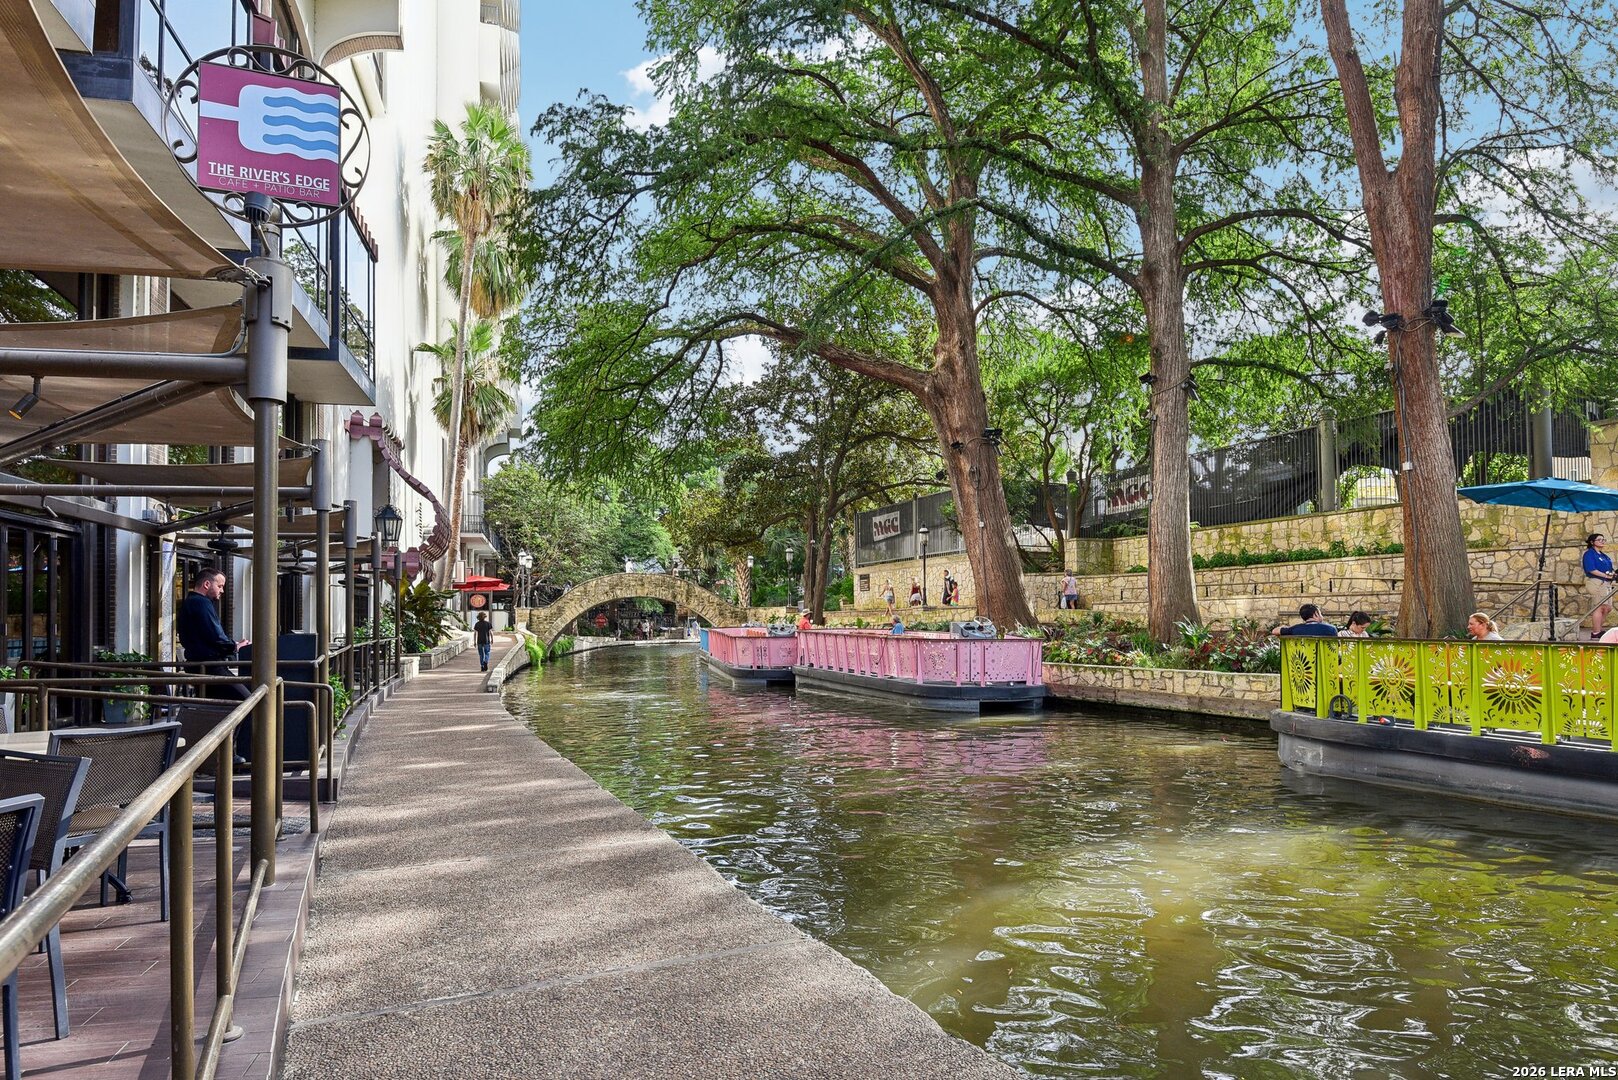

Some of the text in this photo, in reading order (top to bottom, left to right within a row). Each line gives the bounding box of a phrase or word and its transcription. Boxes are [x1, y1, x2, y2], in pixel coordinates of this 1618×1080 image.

[208, 162, 330, 190] THE RIVER'S EDGE
[218, 176, 249, 189] CAFE
[264, 182, 296, 195] PATIO
[299, 186, 320, 198] BAR
